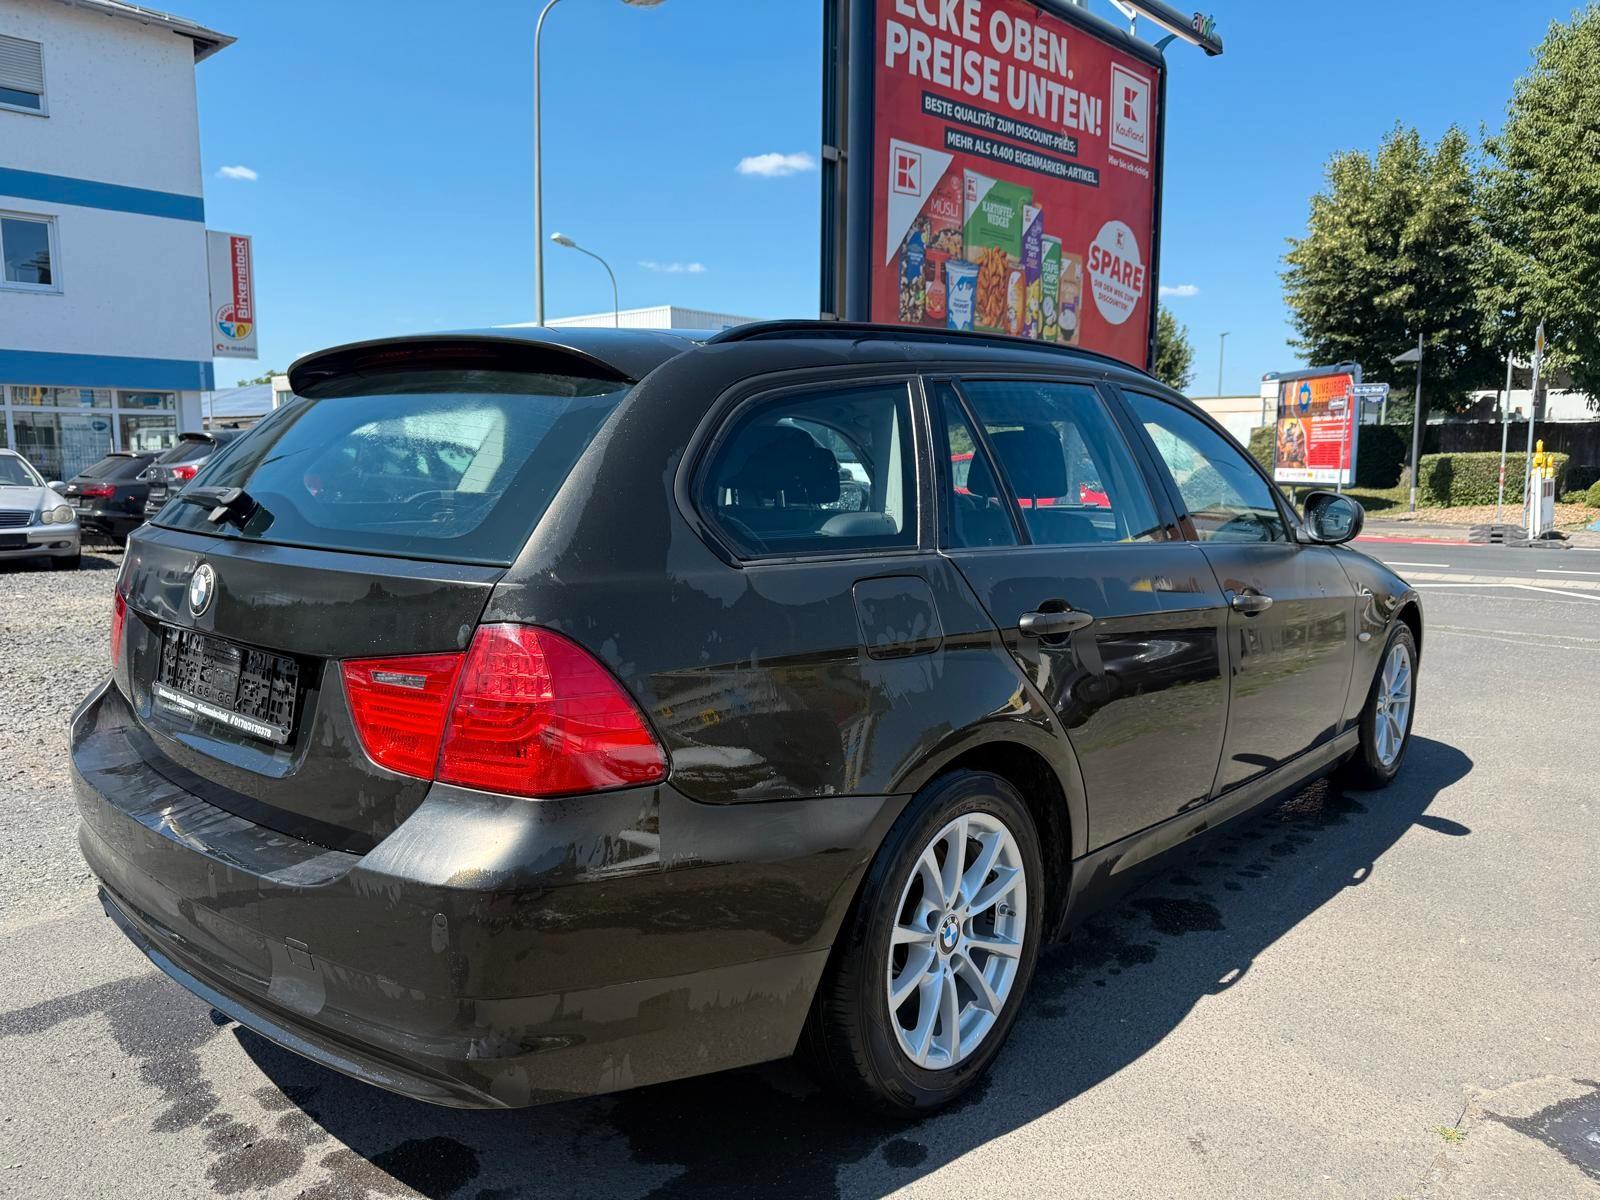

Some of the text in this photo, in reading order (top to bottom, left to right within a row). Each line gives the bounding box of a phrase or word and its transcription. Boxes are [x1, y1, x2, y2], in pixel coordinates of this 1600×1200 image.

[989, 10, 1074, 80] OBEN.
[885, 19, 1102, 137] PREISE UNTEN!
[925, 96, 953, 116] BESTE
[954, 103, 996, 133] QUALITÄT
[996, 118, 1015, 135] ZUM
[1115, 122, 1144, 145] Kaufland
[947, 132, 1098, 184] MEHR ALS 4.400 EIGENMARKEN-ARTIKEL.
[1108, 154, 1118, 167] Hier
[930, 198, 959, 217] MÜSLI
[235, 239, 249, 319] Birkenstock
[1089, 245, 1143, 293] SPARE
